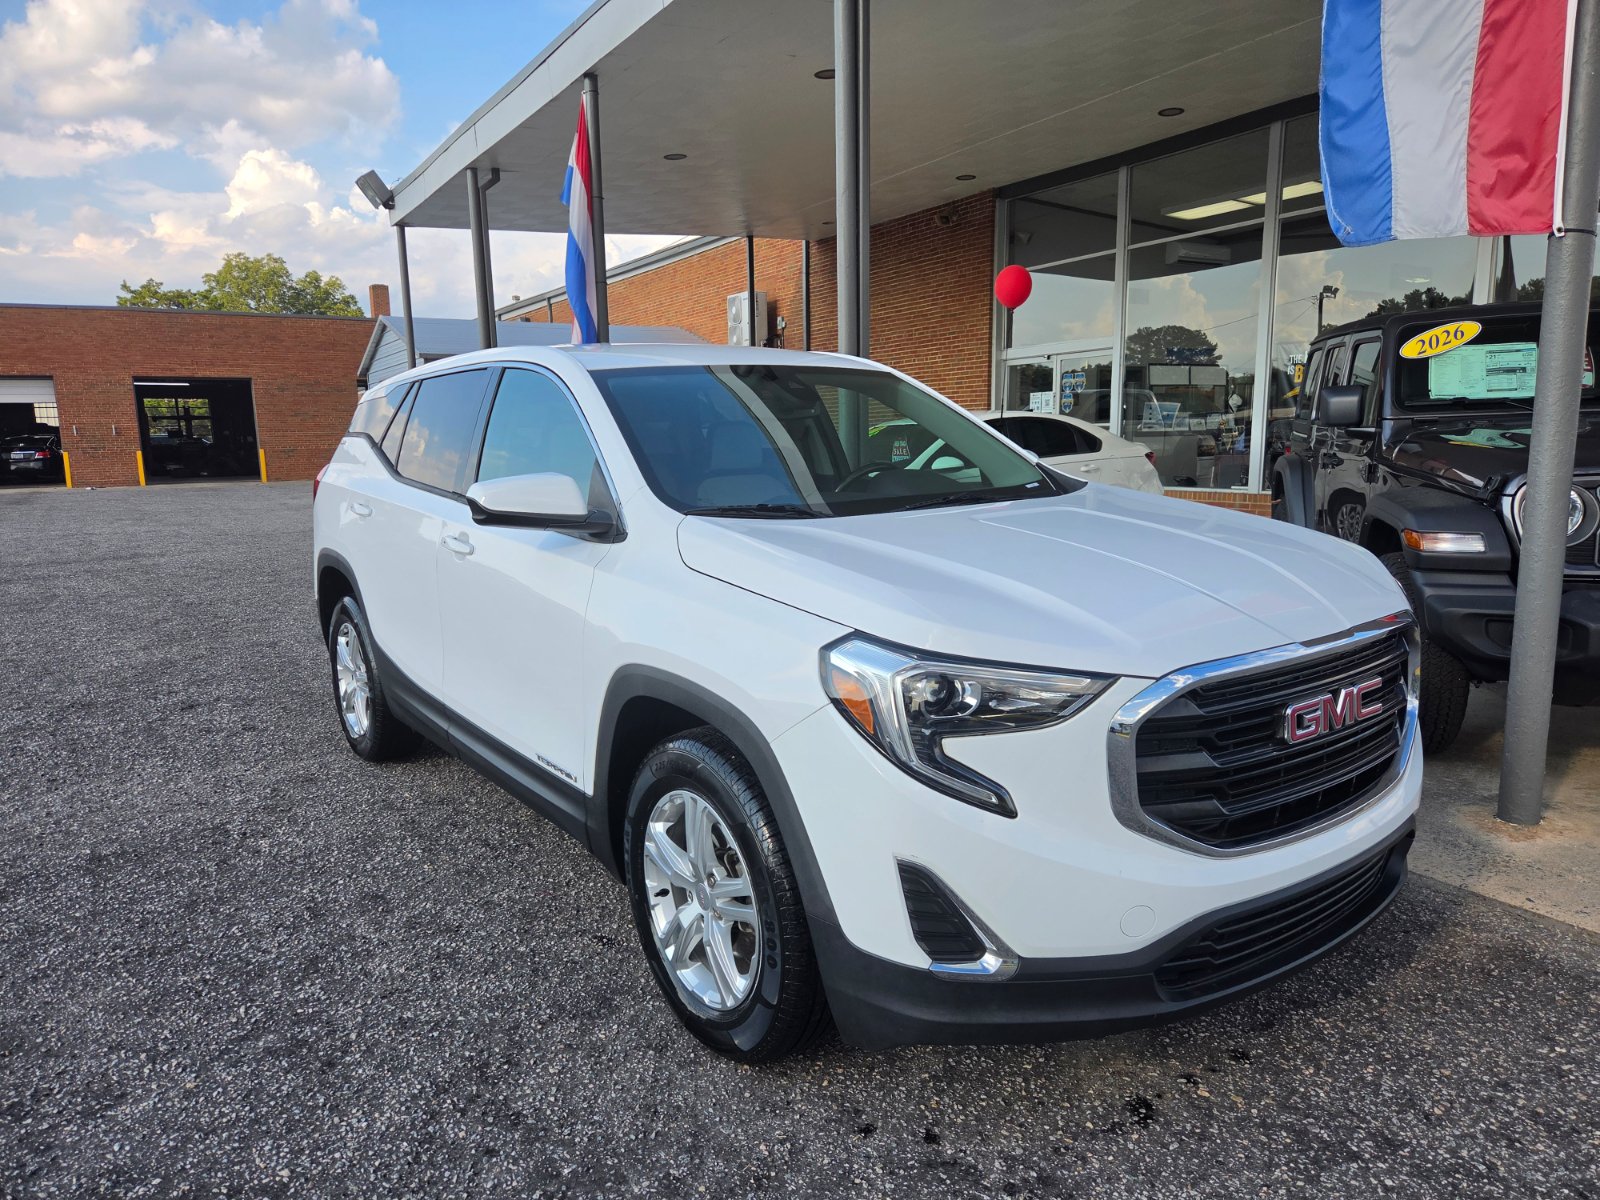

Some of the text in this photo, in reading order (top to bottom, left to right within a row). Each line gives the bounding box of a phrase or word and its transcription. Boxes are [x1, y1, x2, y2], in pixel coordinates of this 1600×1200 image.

[1416, 324, 1464, 355] 2026
[1290, 355, 1302, 363] THE
[1287, 365, 1295, 375] IS
[1284, 677, 1382, 744] GMC
